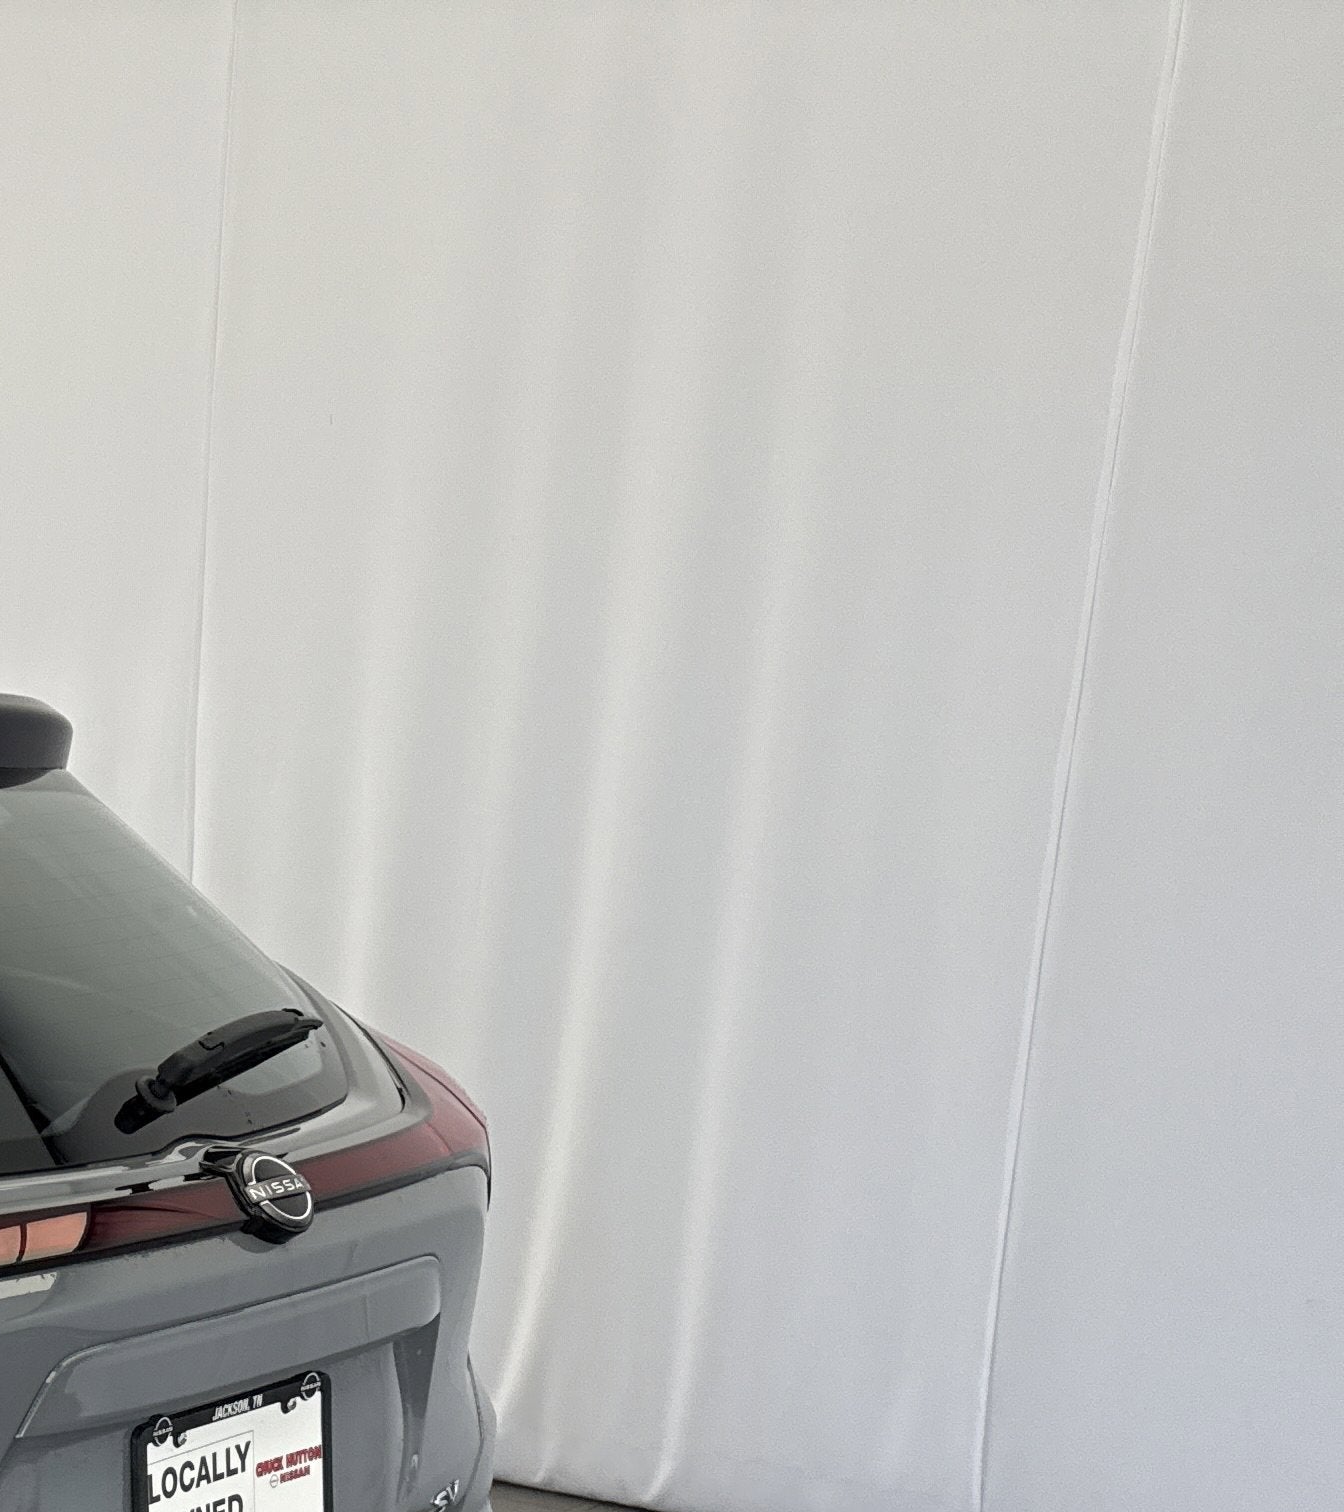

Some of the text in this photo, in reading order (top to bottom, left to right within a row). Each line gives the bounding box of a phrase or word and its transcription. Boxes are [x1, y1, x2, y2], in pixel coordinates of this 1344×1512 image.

[249, 1174, 310, 1200] NISSA
[252, 1393, 263, 1409] TN
[148, 1440, 252, 1505] LOCALLY
